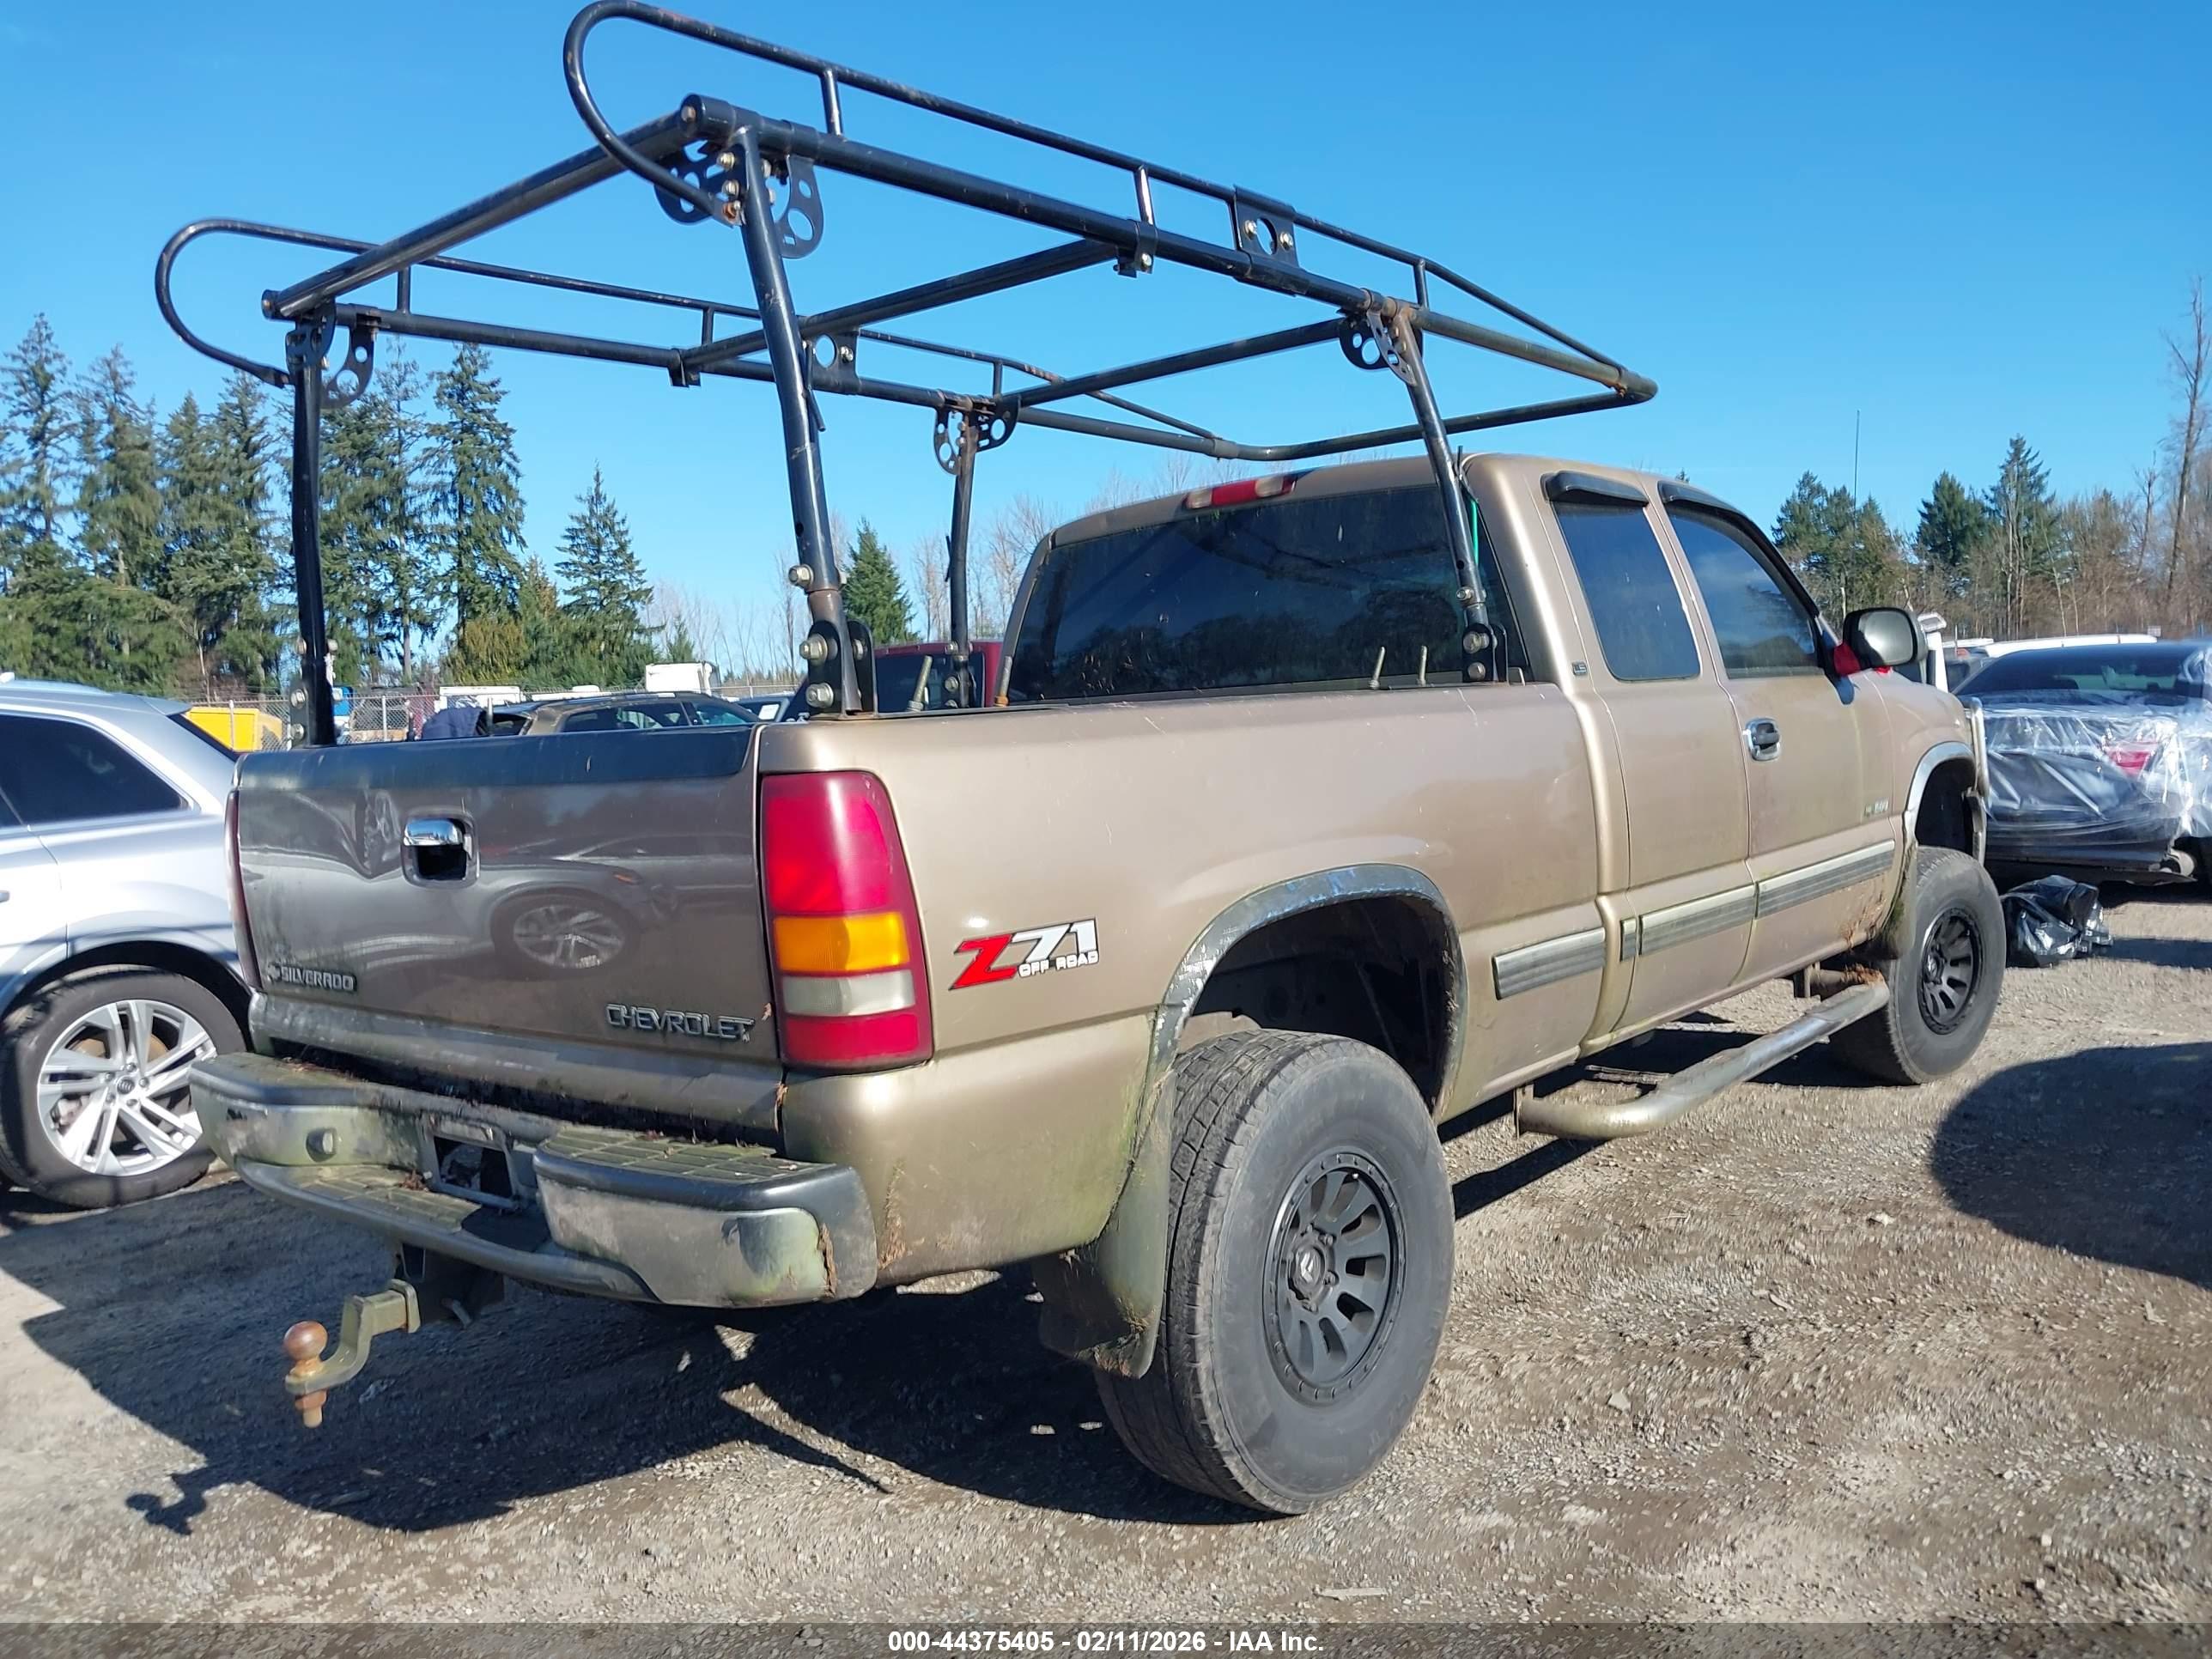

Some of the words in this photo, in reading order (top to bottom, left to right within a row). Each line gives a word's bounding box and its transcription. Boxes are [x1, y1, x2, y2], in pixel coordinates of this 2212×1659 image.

[948, 918, 1098, 991] Z71
[1018, 959, 1050, 978] OFF
[1055, 951, 1099, 970] ROAD
[280, 966, 355, 992] SILVERADO
[605, 1003, 756, 1042] CHEVROLET
